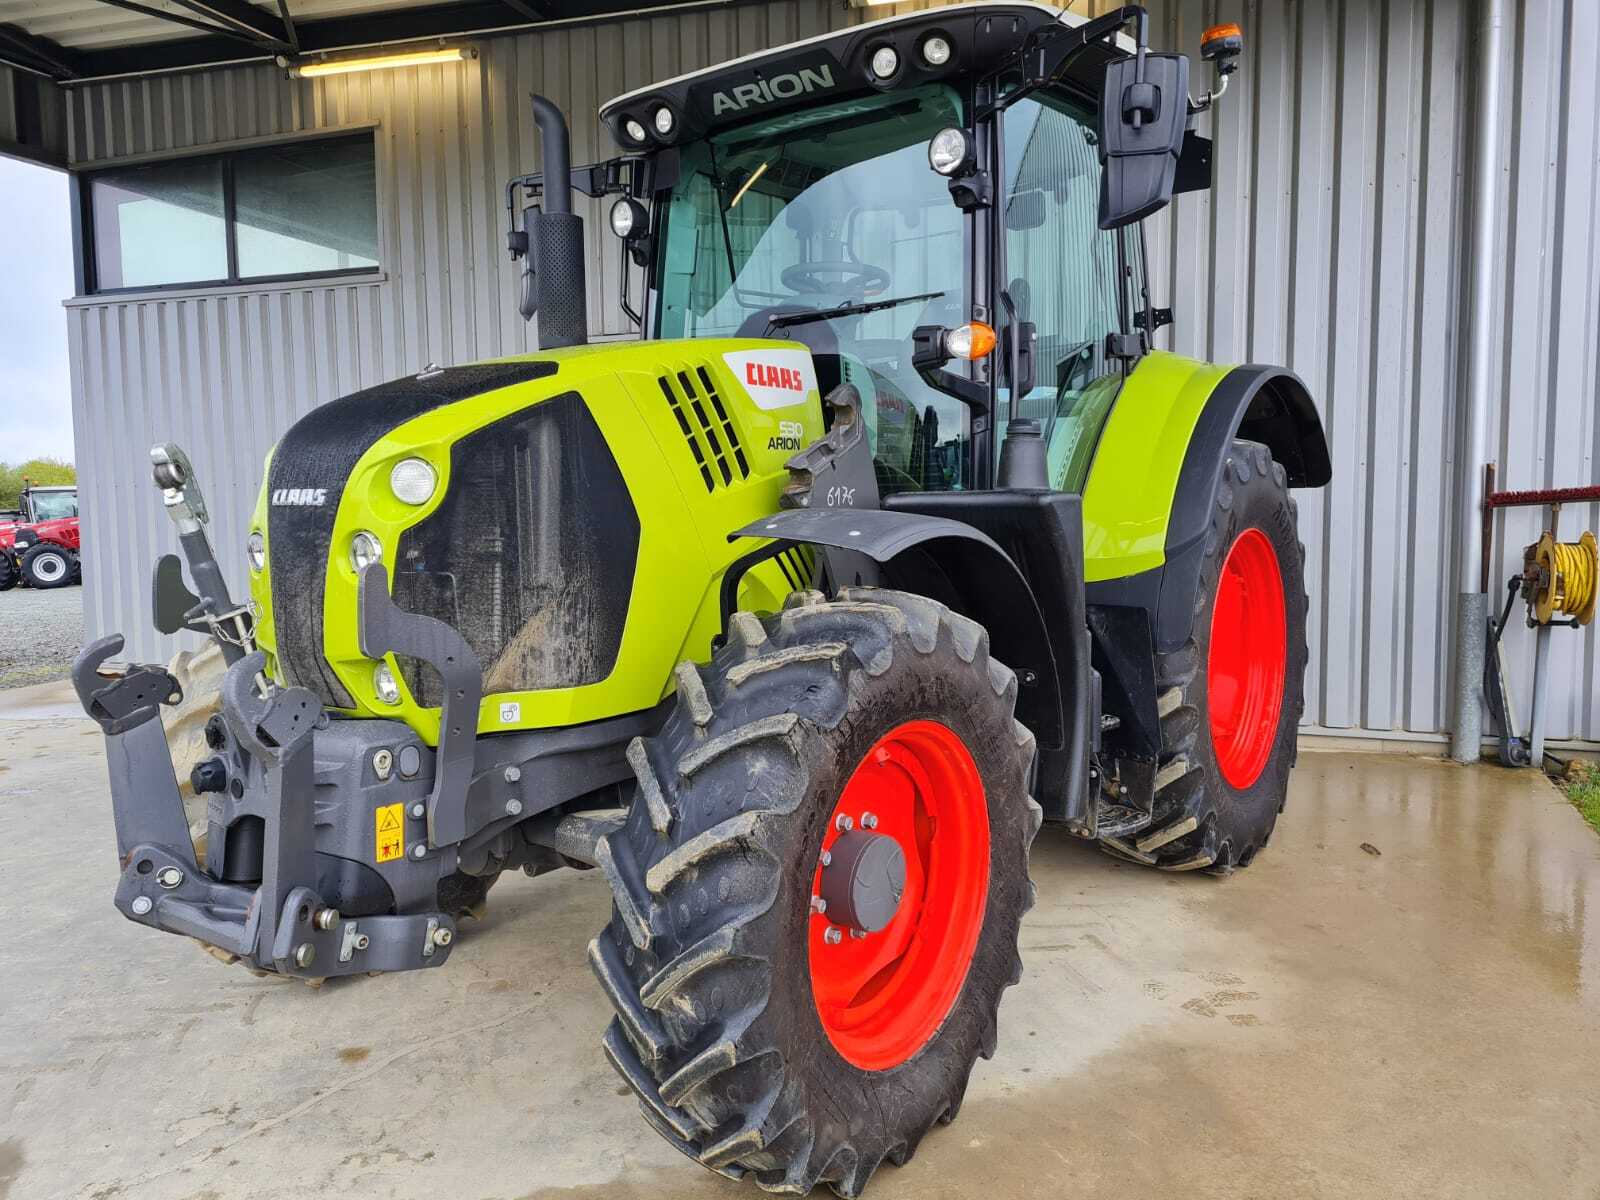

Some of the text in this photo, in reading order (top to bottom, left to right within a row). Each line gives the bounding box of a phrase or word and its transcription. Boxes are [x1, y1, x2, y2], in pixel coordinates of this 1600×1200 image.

[712, 64, 836, 116] ARION
[746, 362, 803, 392] CLAAS
[779, 420, 804, 437] 530
[767, 436, 801, 451] ARION
[272, 488, 328, 506] CLAAS
[827, 486, 856, 507] 6176
